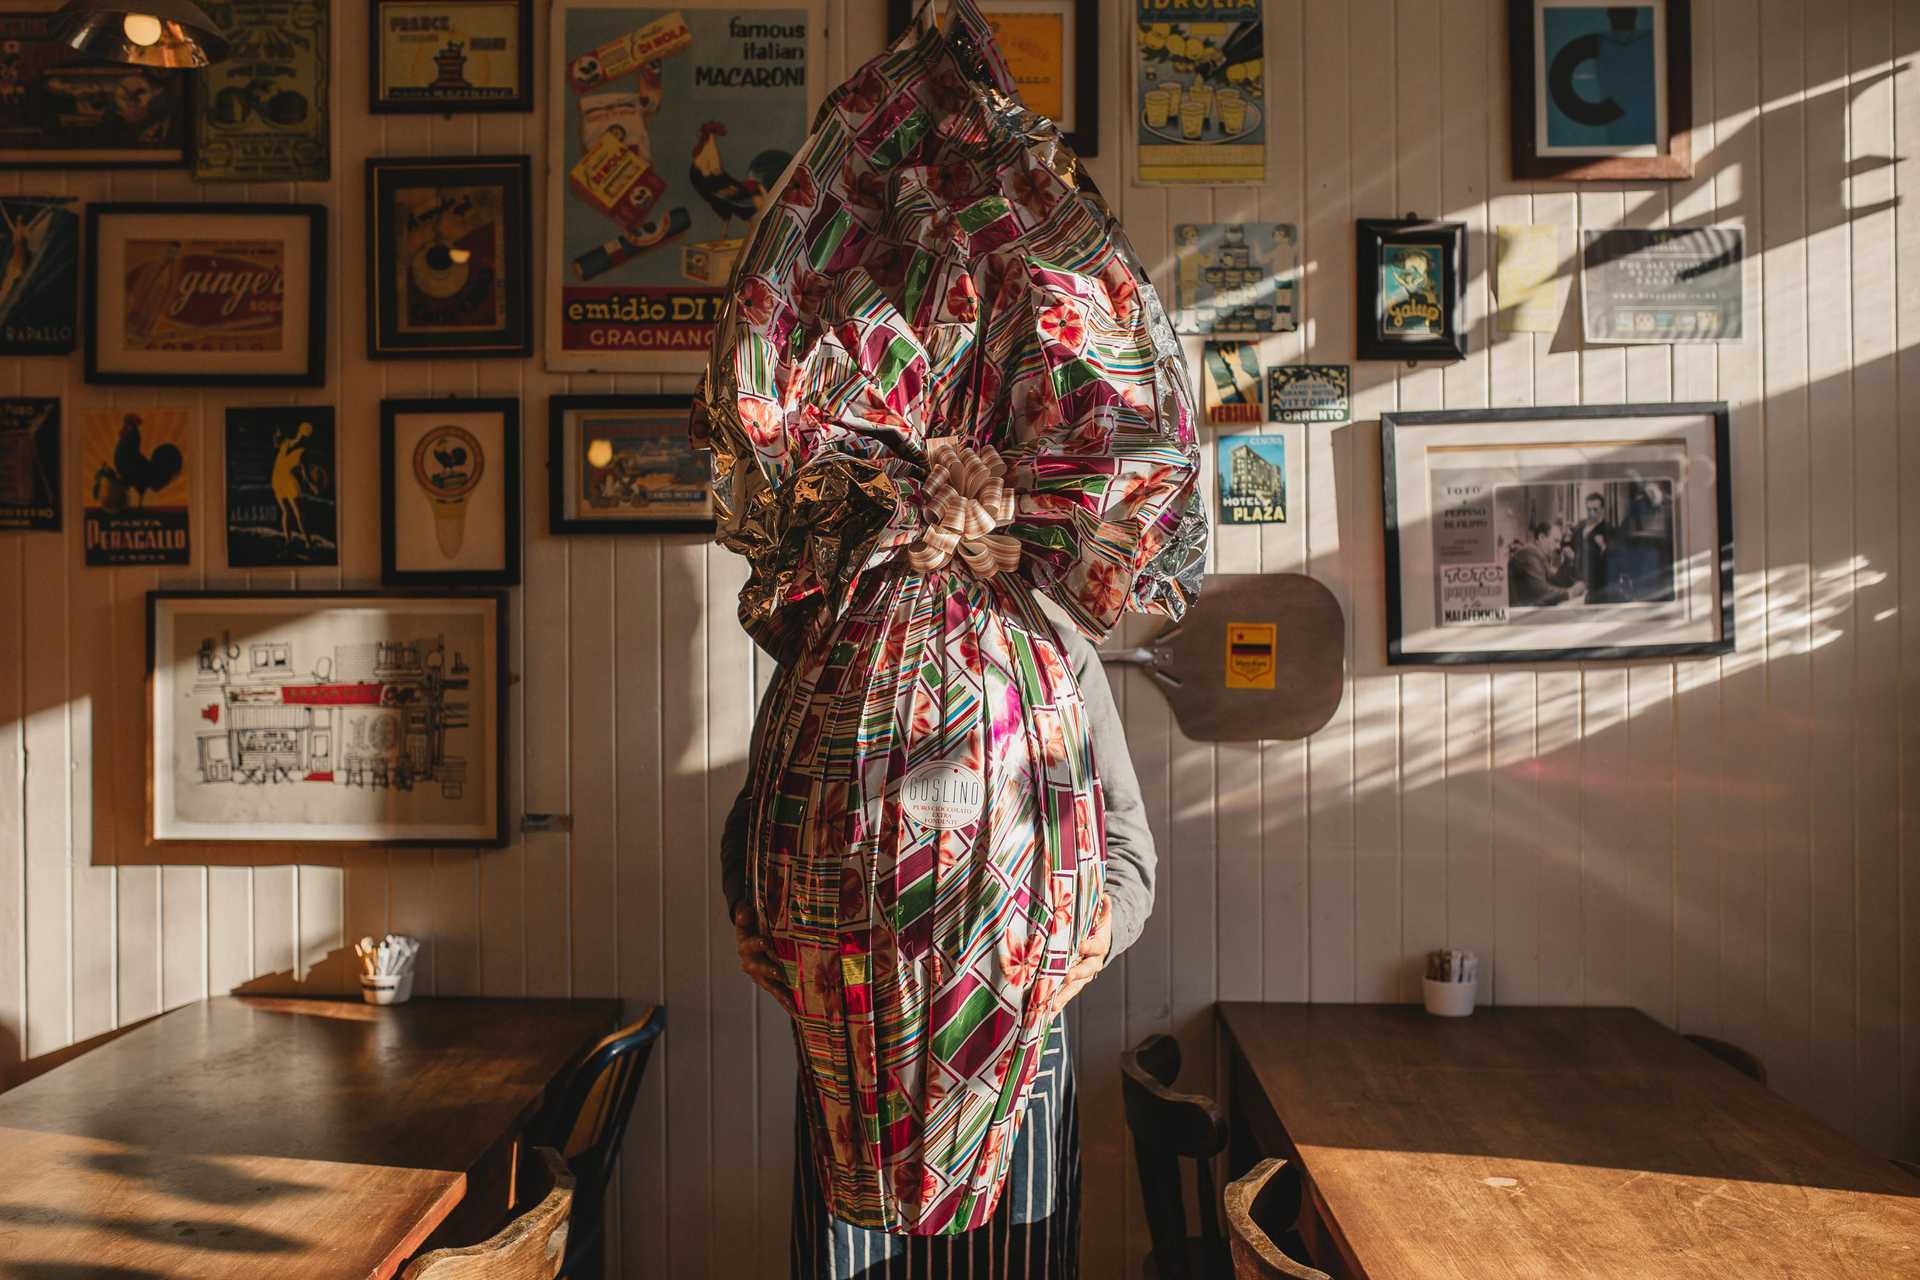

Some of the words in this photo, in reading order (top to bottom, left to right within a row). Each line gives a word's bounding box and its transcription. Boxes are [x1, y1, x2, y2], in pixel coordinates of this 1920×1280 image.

[729, 16, 805, 39] famous
[743, 42, 805, 60] italian
[696, 67, 805, 86] MACARONI
[568, 296, 667, 321] emidio
[671, 298, 705, 321] DI
[1275, 410, 1345, 422] SORRENTO
[1223, 497, 1262, 507] HOTEL
[1233, 507, 1285, 522] PLAZA
[909, 777, 979, 806] GOSLINO
